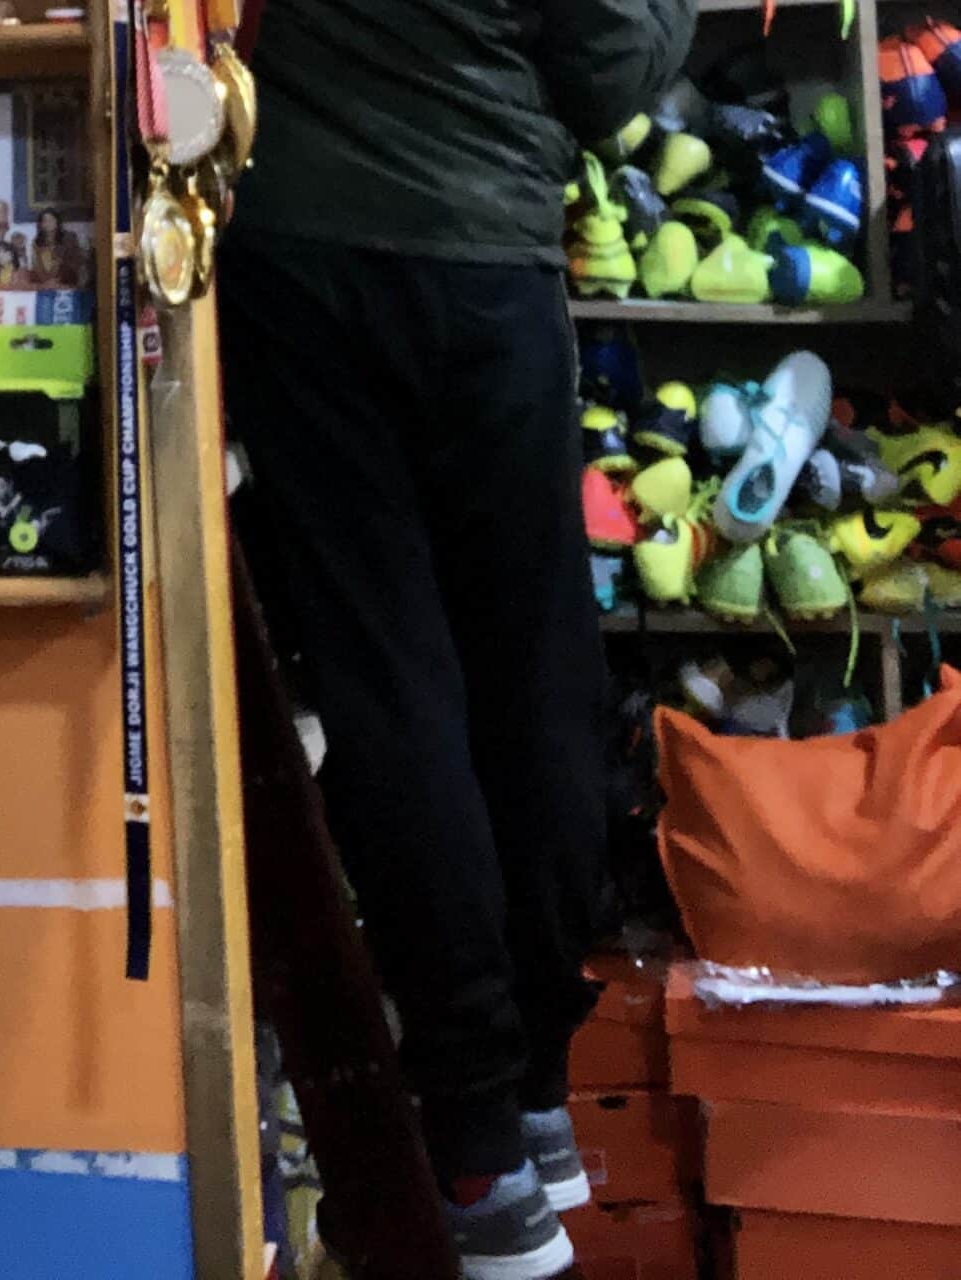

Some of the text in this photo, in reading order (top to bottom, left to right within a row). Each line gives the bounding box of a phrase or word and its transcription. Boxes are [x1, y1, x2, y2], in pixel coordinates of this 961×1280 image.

[120, 321, 135, 454] CHAMPIONSHIP
[122, 458, 136, 495] CUP
[123, 498, 138, 547] GOLD
[124, 551, 140, 666] WANGCHUCK
[127, 672, 141, 726] DORJI
